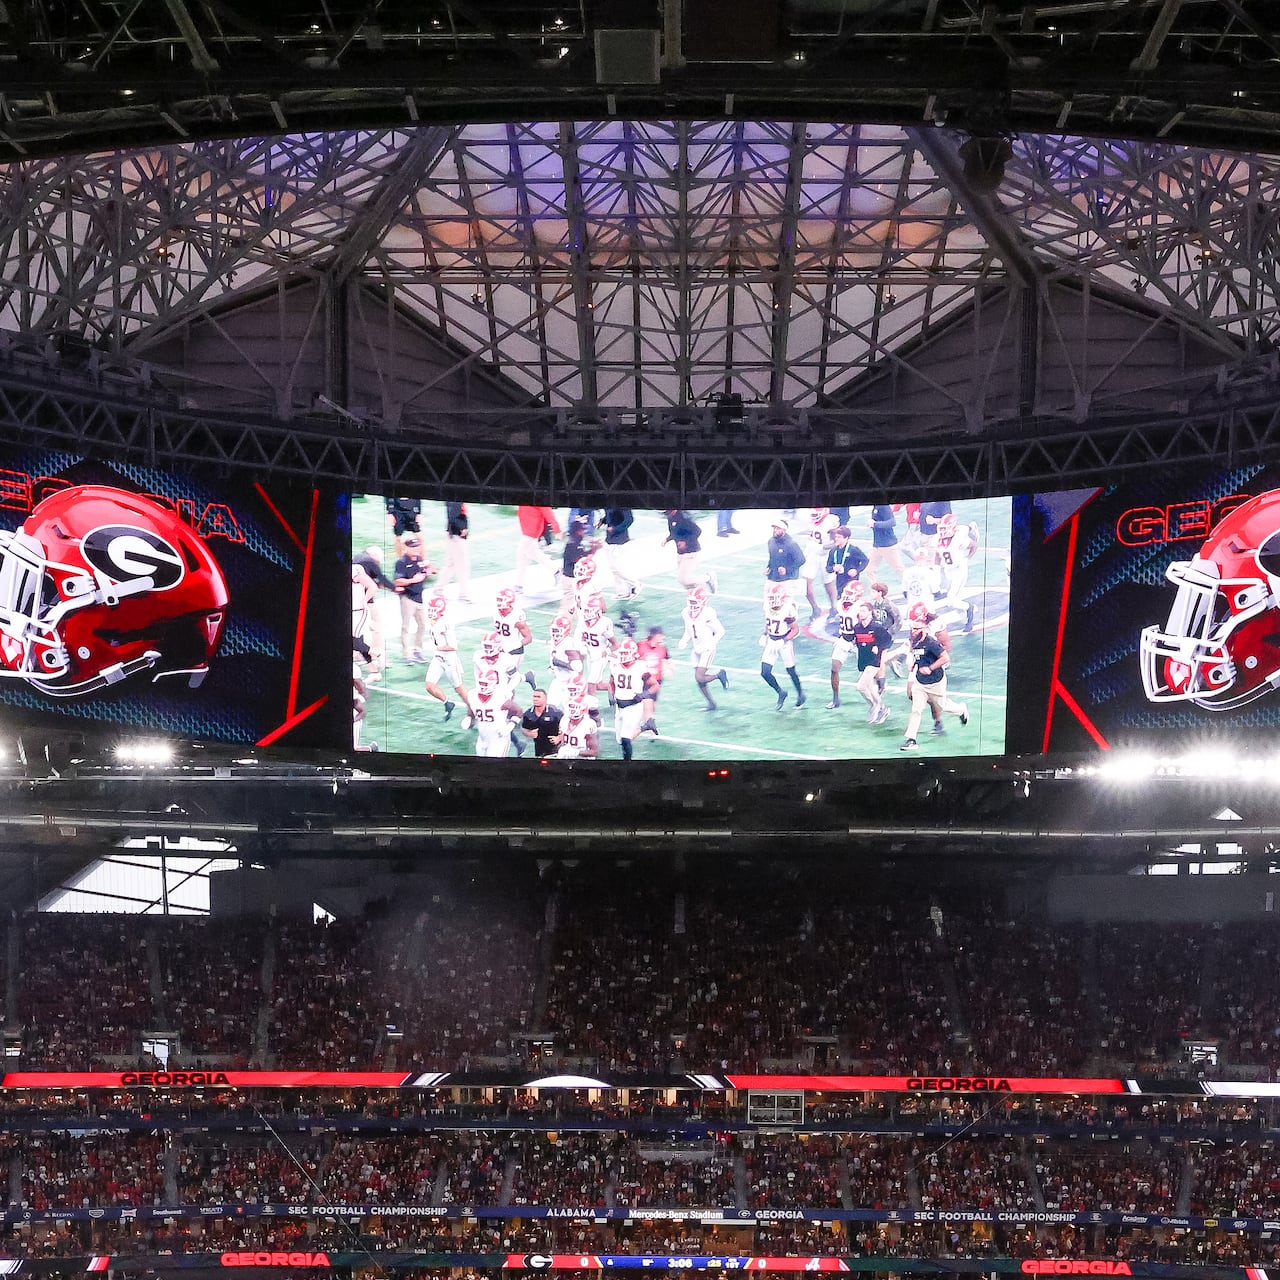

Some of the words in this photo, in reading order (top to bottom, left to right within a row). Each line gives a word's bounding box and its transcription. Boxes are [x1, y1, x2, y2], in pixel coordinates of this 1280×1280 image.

[944, 551, 952, 565] 8
[122, 1073, 230, 1087] GEORGIA
[907, 1078, 1011, 1091] GEORGIA
[288, 1206, 308, 1215] SEC
[312, 1205, 366, 1215] FOOTBALL
[370, 1205, 448, 1216] CHAMPIONSHIP
[546, 1208, 597, 1217] ALABAMA
[628, 1209, 689, 1220] Mercedes-Benz
[691, 1209, 724, 1220] Stadium
[754, 1210, 804, 1219] GEORGIA
[914, 1211, 934, 1221] SEC
[938, 1211, 993, 1222] FOOTBALL
[998, 1212, 1076, 1222] CHAMPIONSHIP
[220, 1252, 331, 1267] GEORGIA
[667, 1258, 693, 1269] 3:06
[1021, 1260, 1133, 1276] GEORGIA
